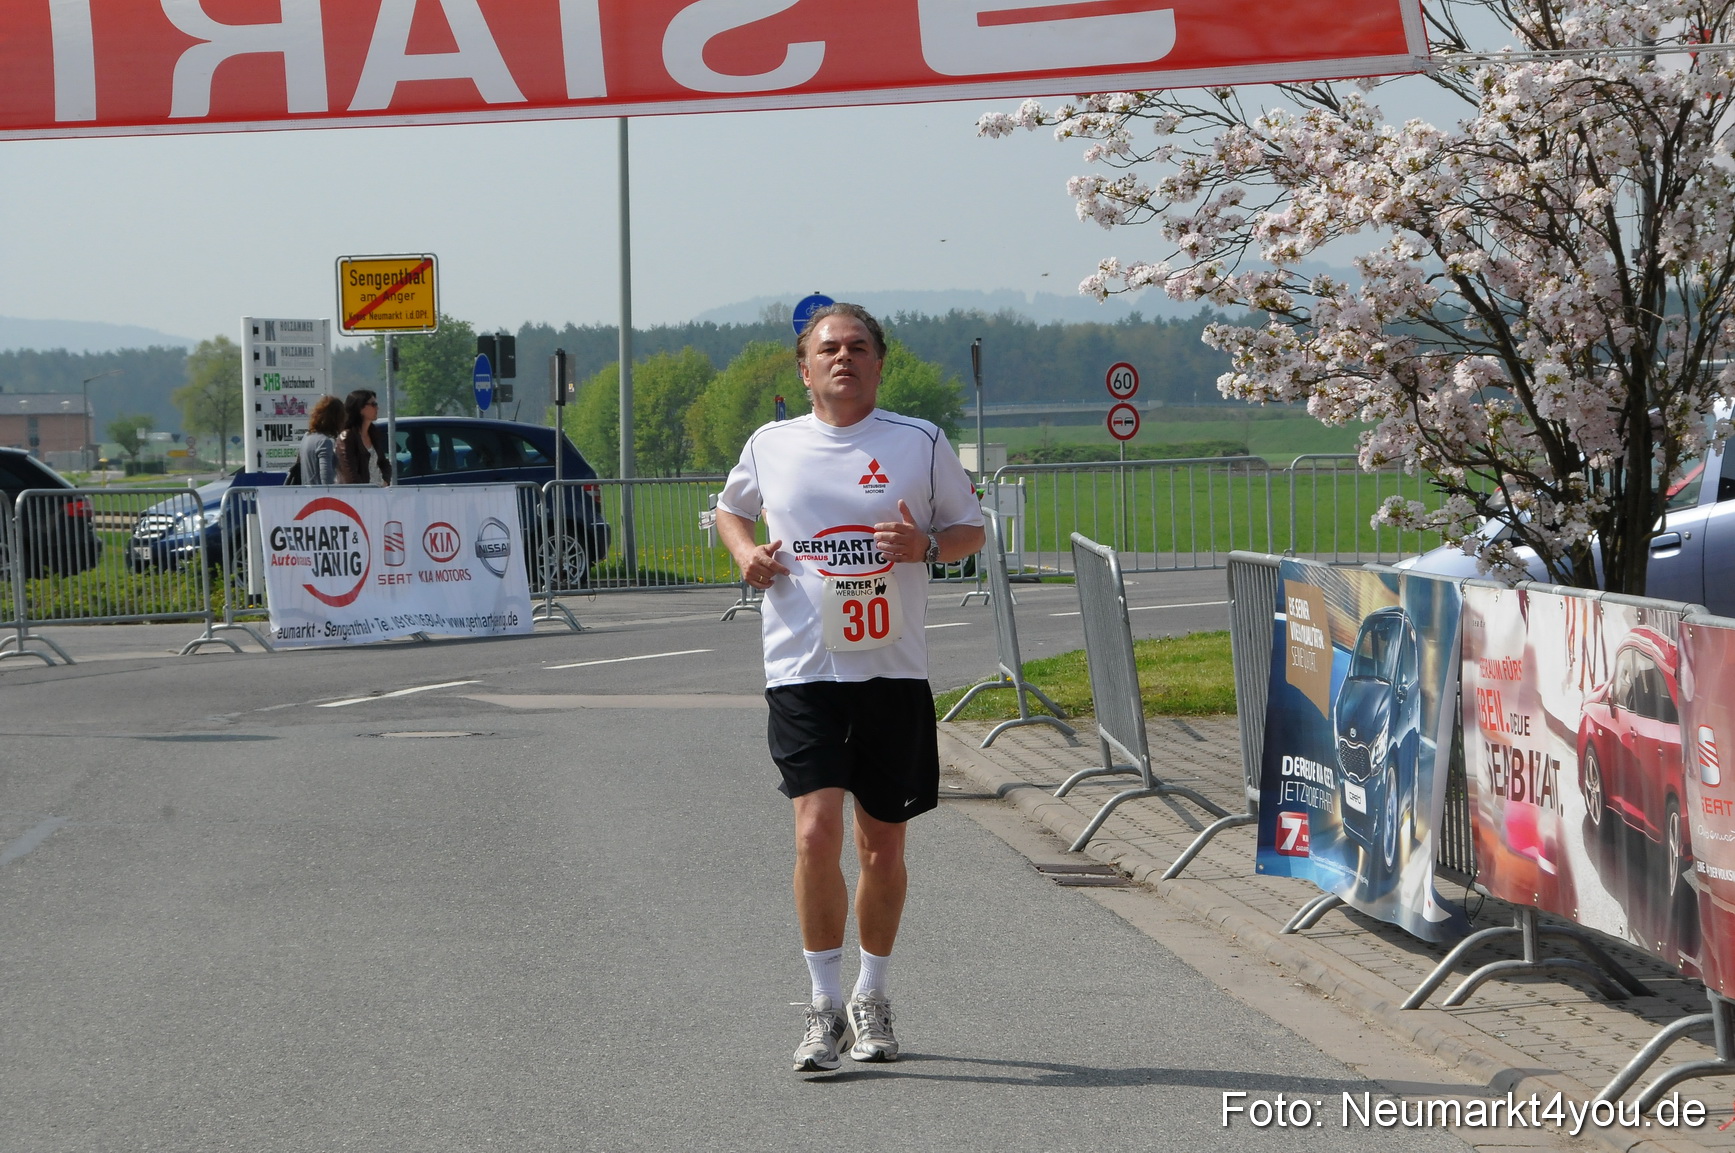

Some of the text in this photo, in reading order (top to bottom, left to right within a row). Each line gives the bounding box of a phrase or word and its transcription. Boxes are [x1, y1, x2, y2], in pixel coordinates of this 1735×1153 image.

[349, 267, 426, 290] Sengenthal
[360, 290, 416, 304] am Anger
[369, 310, 402, 320] Neumarkt
[263, 373, 281, 391] SHB
[1113, 372, 1132, 389] 60
[264, 424, 293, 442] THULE
[270, 526, 350, 551] GERHART
[429, 532, 454, 553] KIA
[793, 539, 874, 553] GERHART
[312, 551, 362, 577] JÄNIG
[378, 573, 413, 585] SEAT
[418, 568, 472, 583] KIA MOTORS
[835, 580, 872, 590] MEYER
[835, 589, 873, 597] WERBUNG
[842, 597, 890, 642] 30
[1280, 817, 1303, 850] 7
